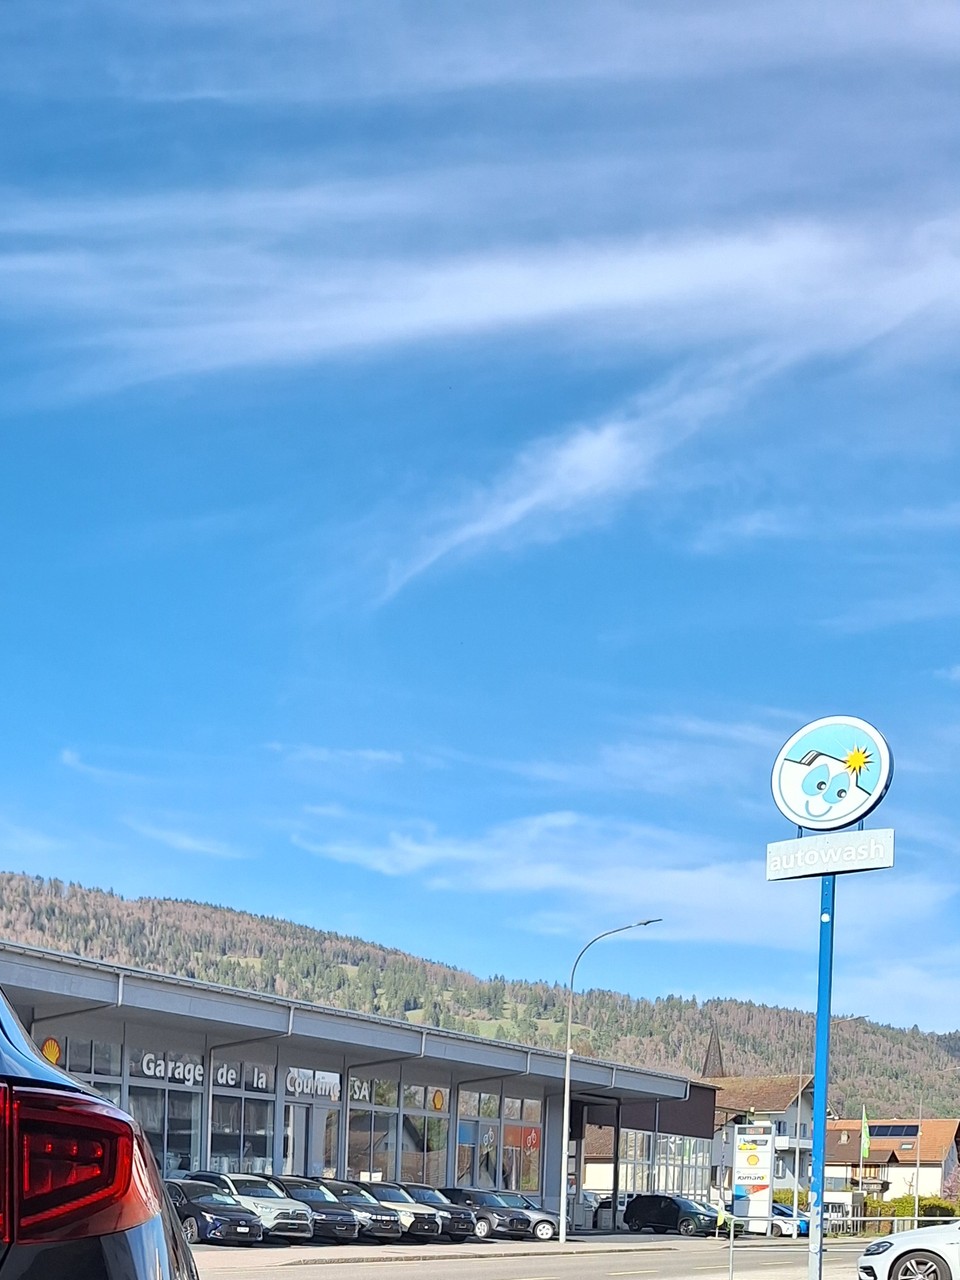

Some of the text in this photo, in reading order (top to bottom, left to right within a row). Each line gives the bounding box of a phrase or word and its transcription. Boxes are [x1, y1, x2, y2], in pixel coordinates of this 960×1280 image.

[770, 838, 885, 872] autowash
[142, 1053, 370, 1101] Garage de la Courtine SA
